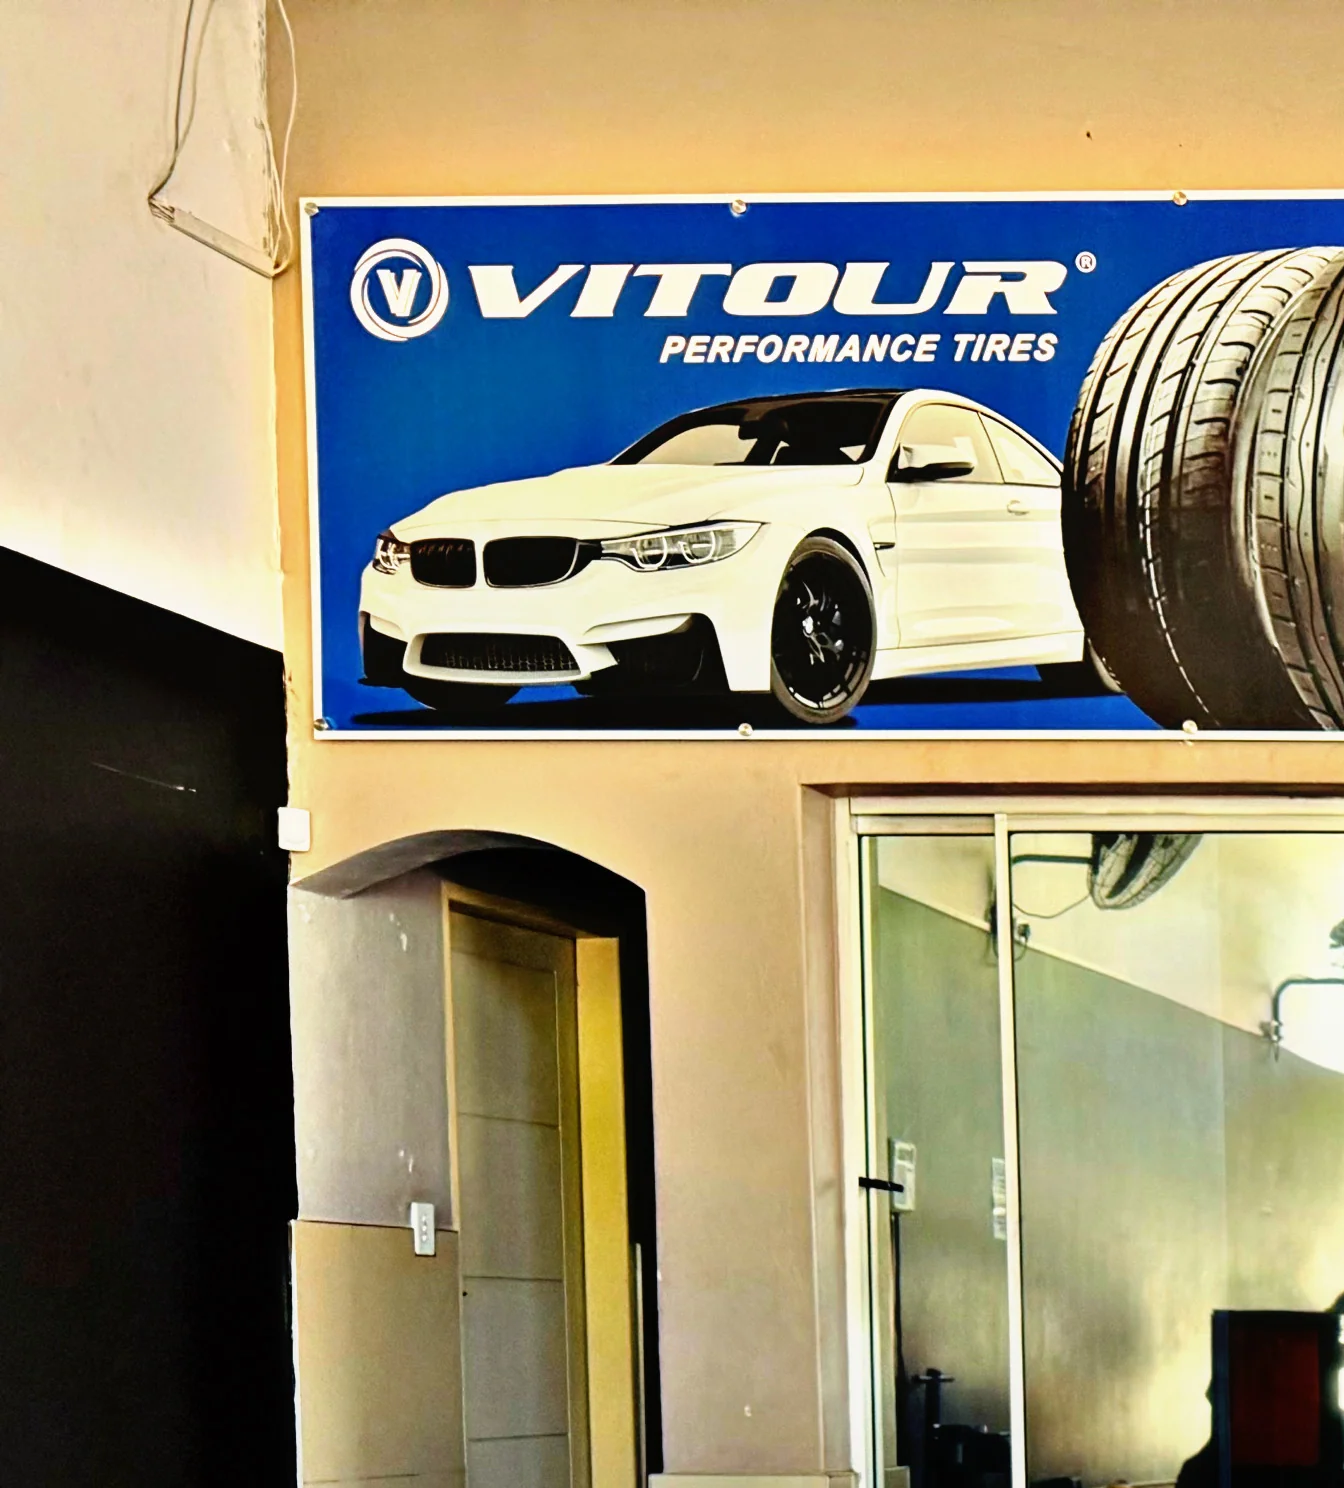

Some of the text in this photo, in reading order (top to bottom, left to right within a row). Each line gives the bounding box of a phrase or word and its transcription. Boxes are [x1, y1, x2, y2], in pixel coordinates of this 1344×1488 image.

[468, 260, 1068, 318] VITOUR
[659, 332, 1059, 364] PERFORMANCE TIRES
